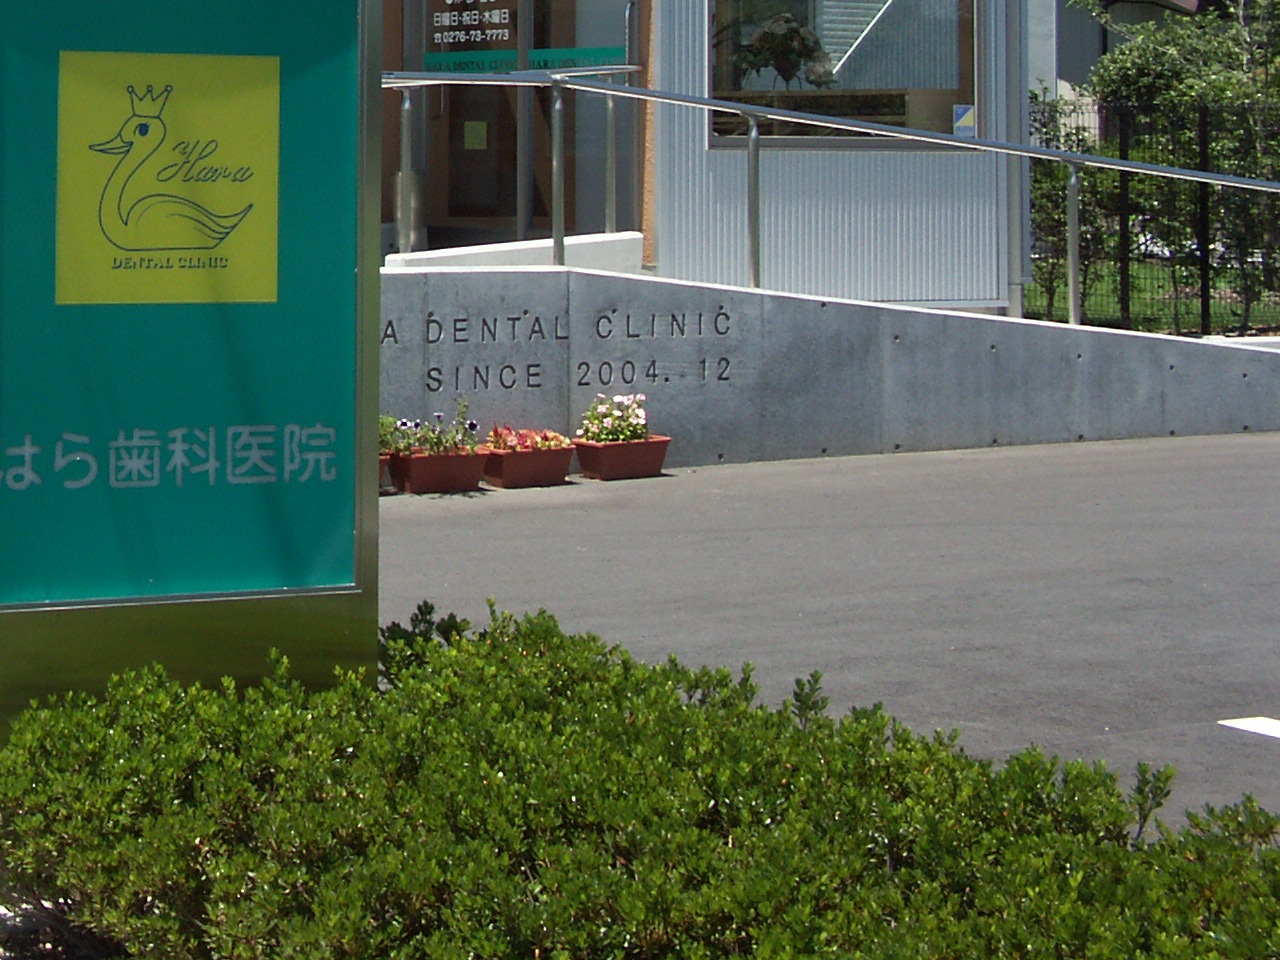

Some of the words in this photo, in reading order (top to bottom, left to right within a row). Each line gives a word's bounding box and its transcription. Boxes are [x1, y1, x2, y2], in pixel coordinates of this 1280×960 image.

[111, 257, 174, 270] DENTAL
[178, 256, 229, 269] CLINIC
[426, 316, 569, 343] DENTAL
[596, 312, 730, 340] CLINIC
[426, 363, 542, 392] SINCE
